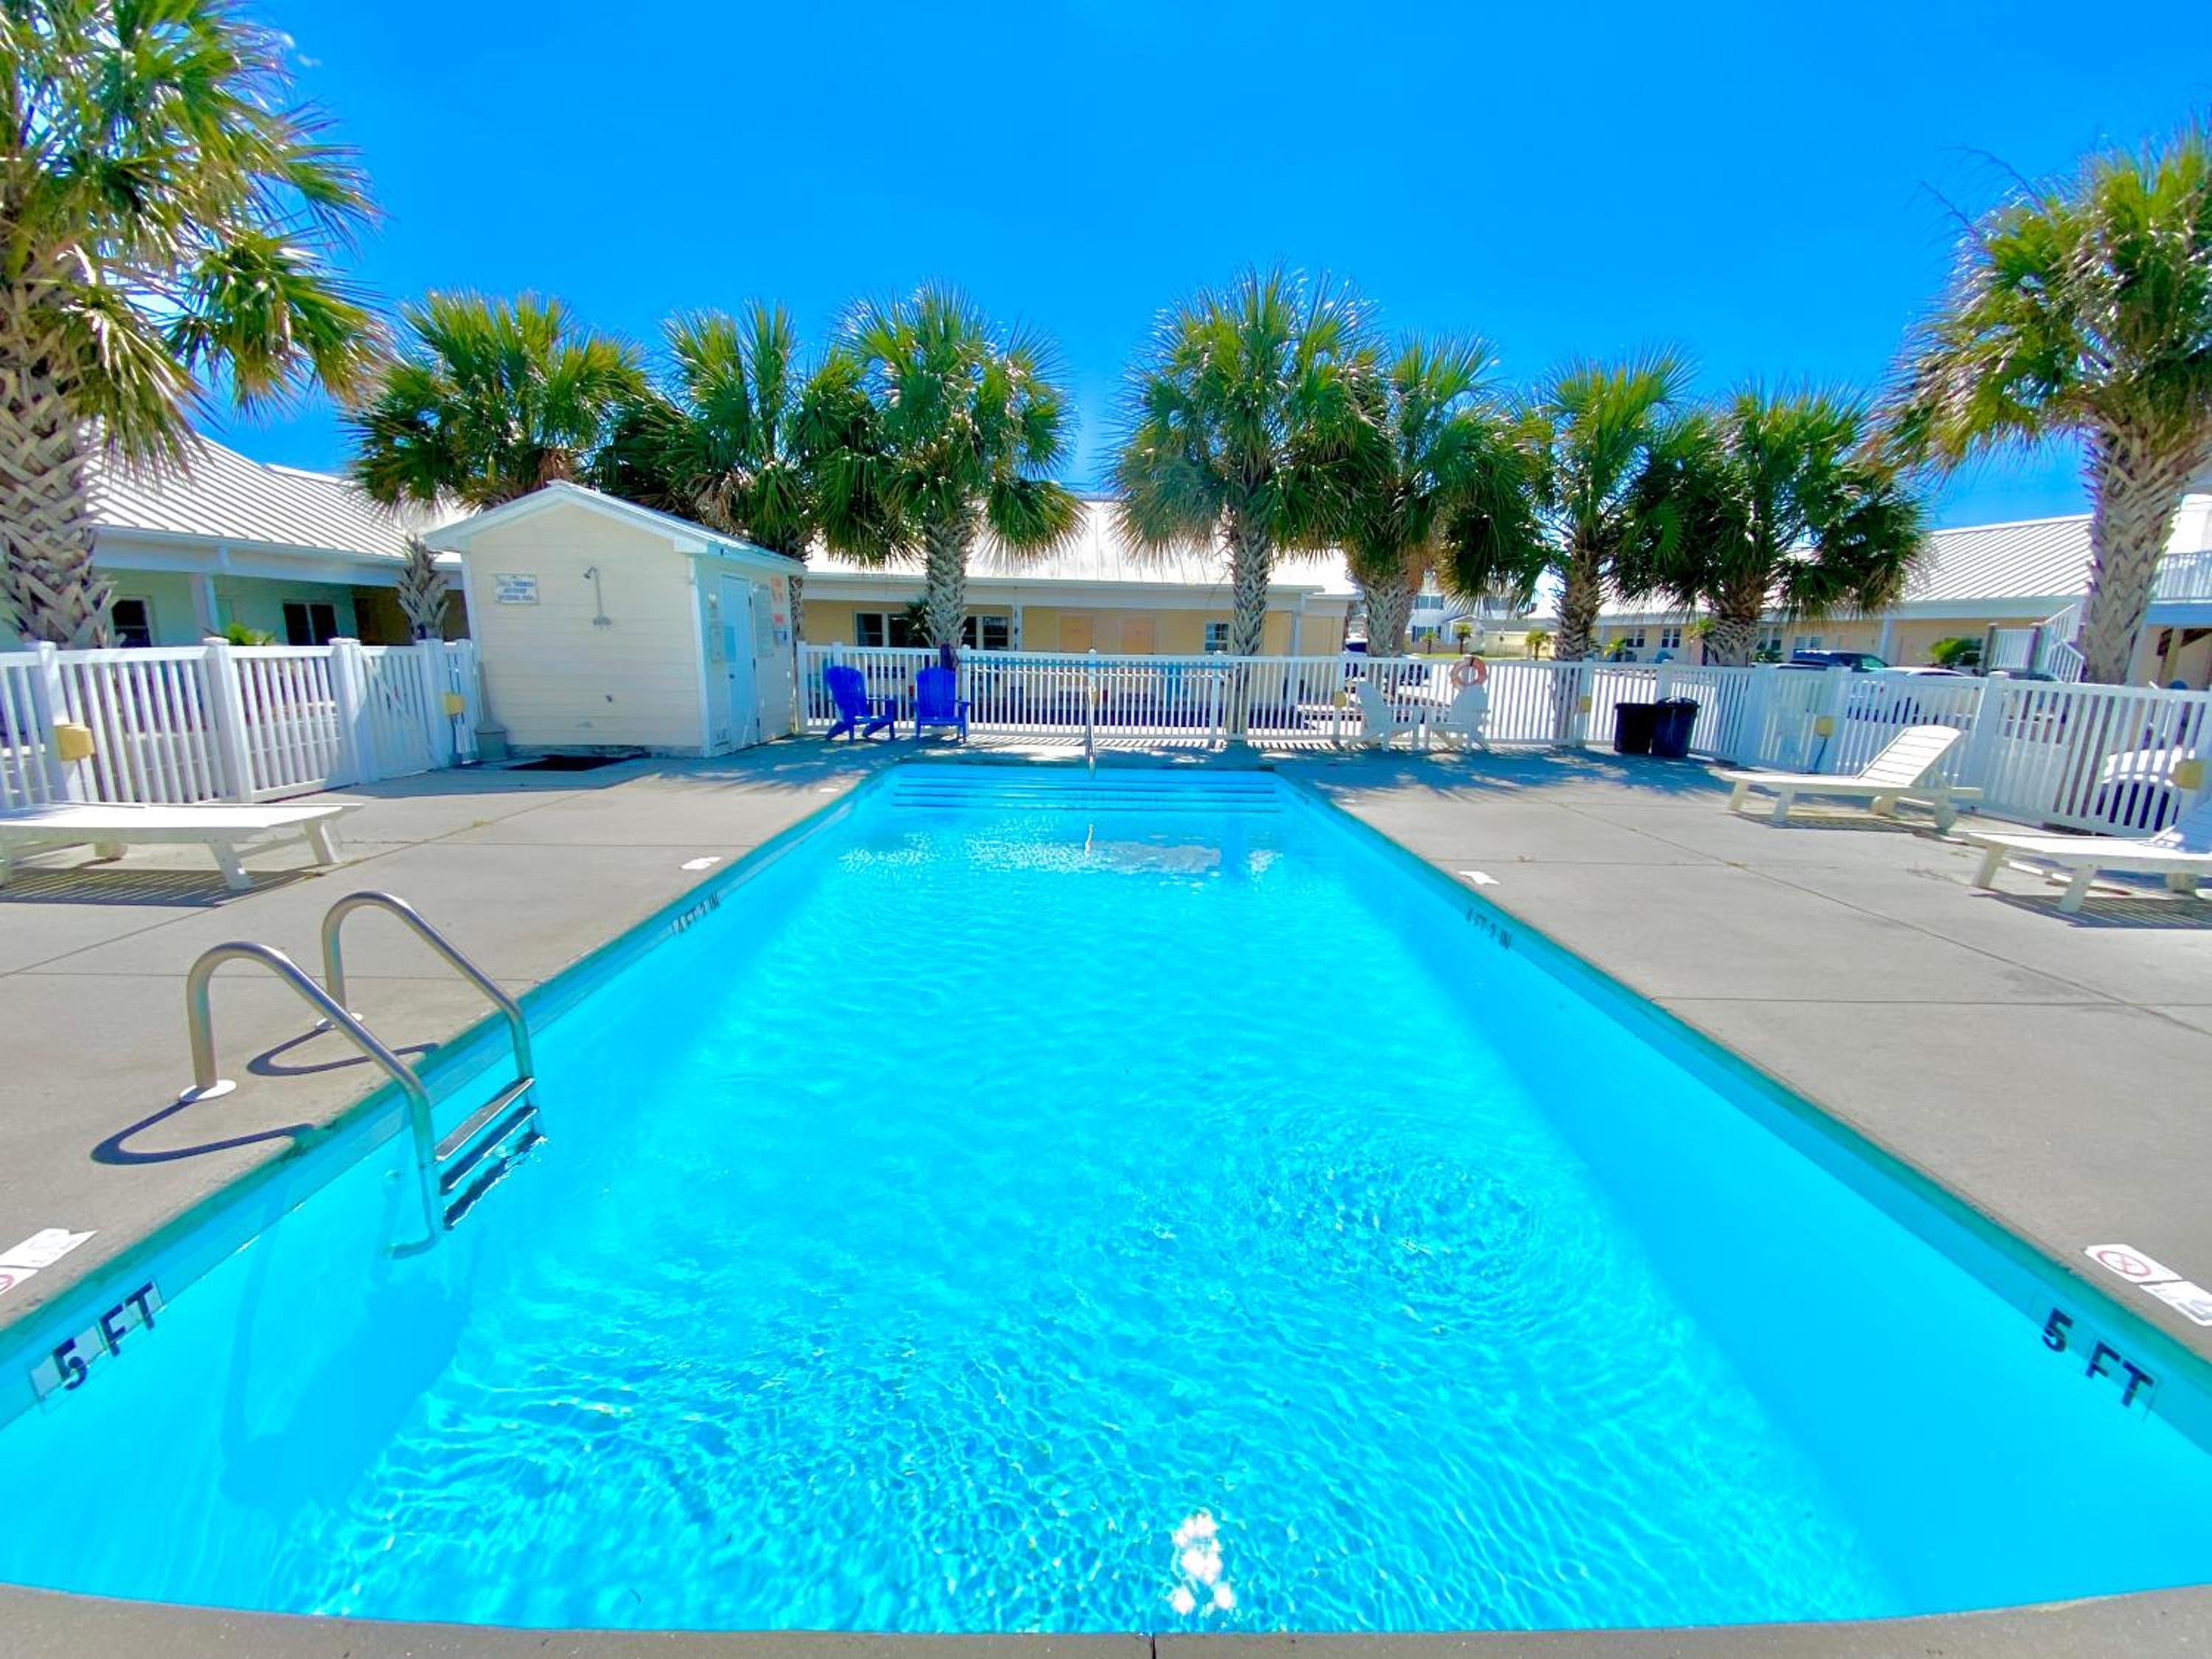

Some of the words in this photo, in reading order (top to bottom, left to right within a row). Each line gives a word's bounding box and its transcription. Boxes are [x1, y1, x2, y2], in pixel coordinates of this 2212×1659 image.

[53, 1338, 88, 1391] 5
[99, 1281, 155, 1357] FT
[2042, 1307, 2073, 1353] 5
[2085, 1341, 2154, 1408] FT
